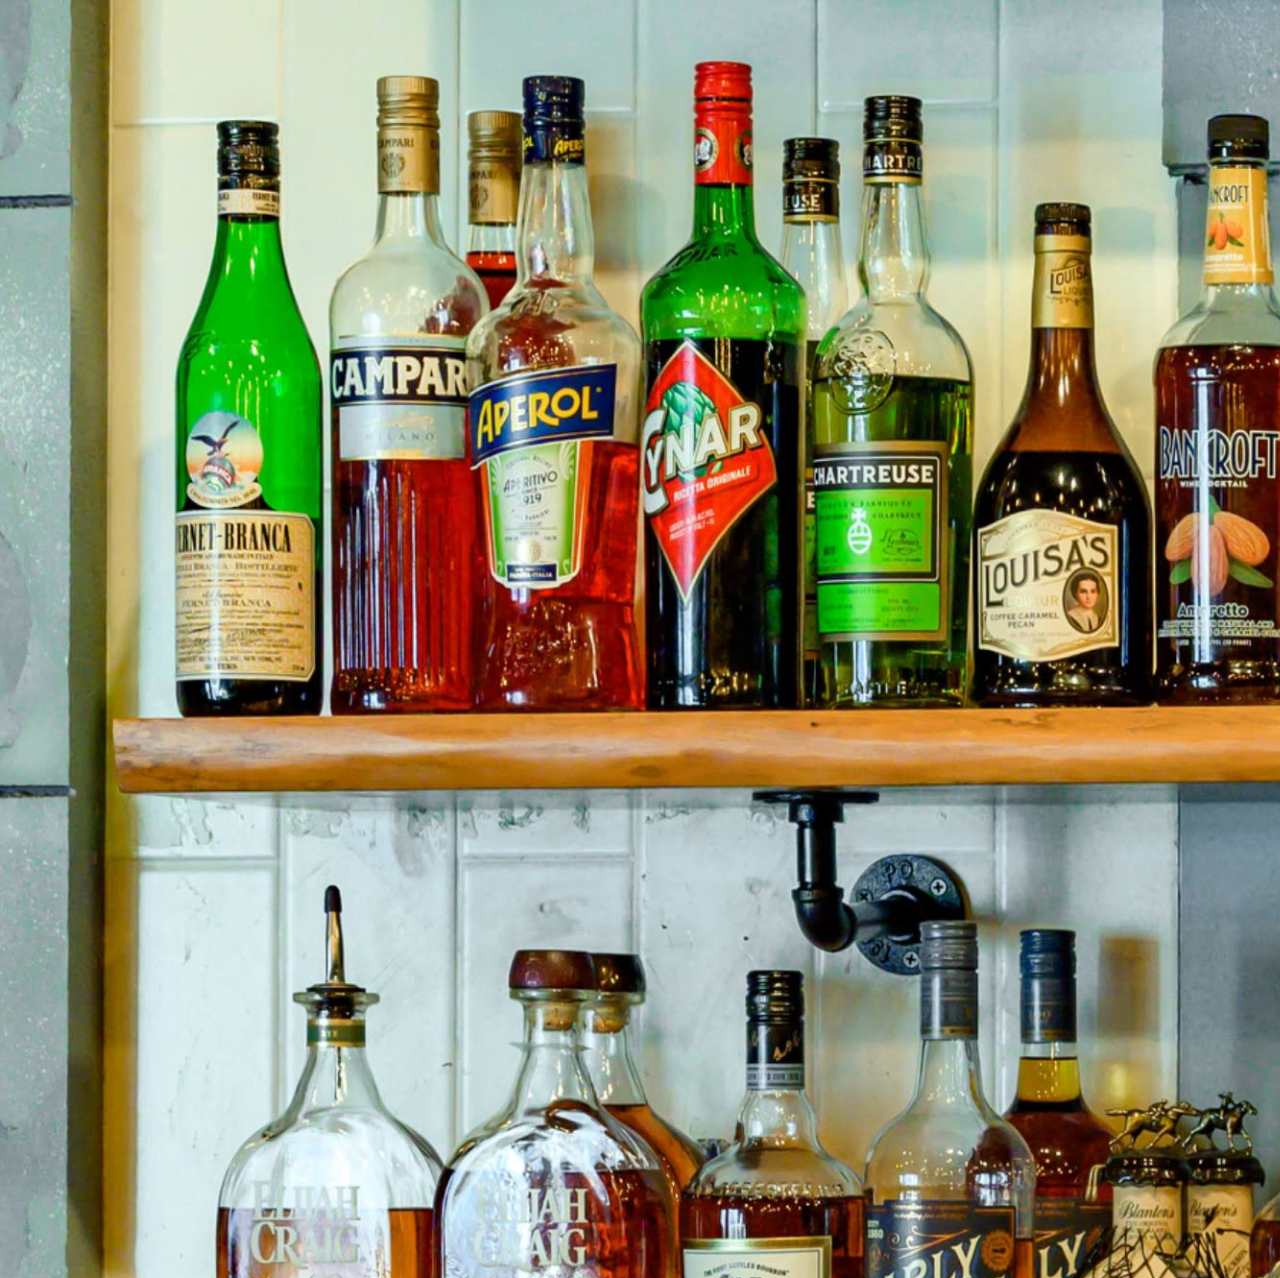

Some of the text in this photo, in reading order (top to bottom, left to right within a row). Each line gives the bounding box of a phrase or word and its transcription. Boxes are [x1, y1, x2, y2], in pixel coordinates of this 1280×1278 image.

[332, 353, 471, 398] CAMPAR
[477, 385, 599, 449] APEROL
[641, 401, 764, 516] CYNAR
[814, 463, 934, 486] CHARTREUSE
[983, 535, 1109, 608] LOUISA'S
[252, 1220, 362, 1266] CRAIG
